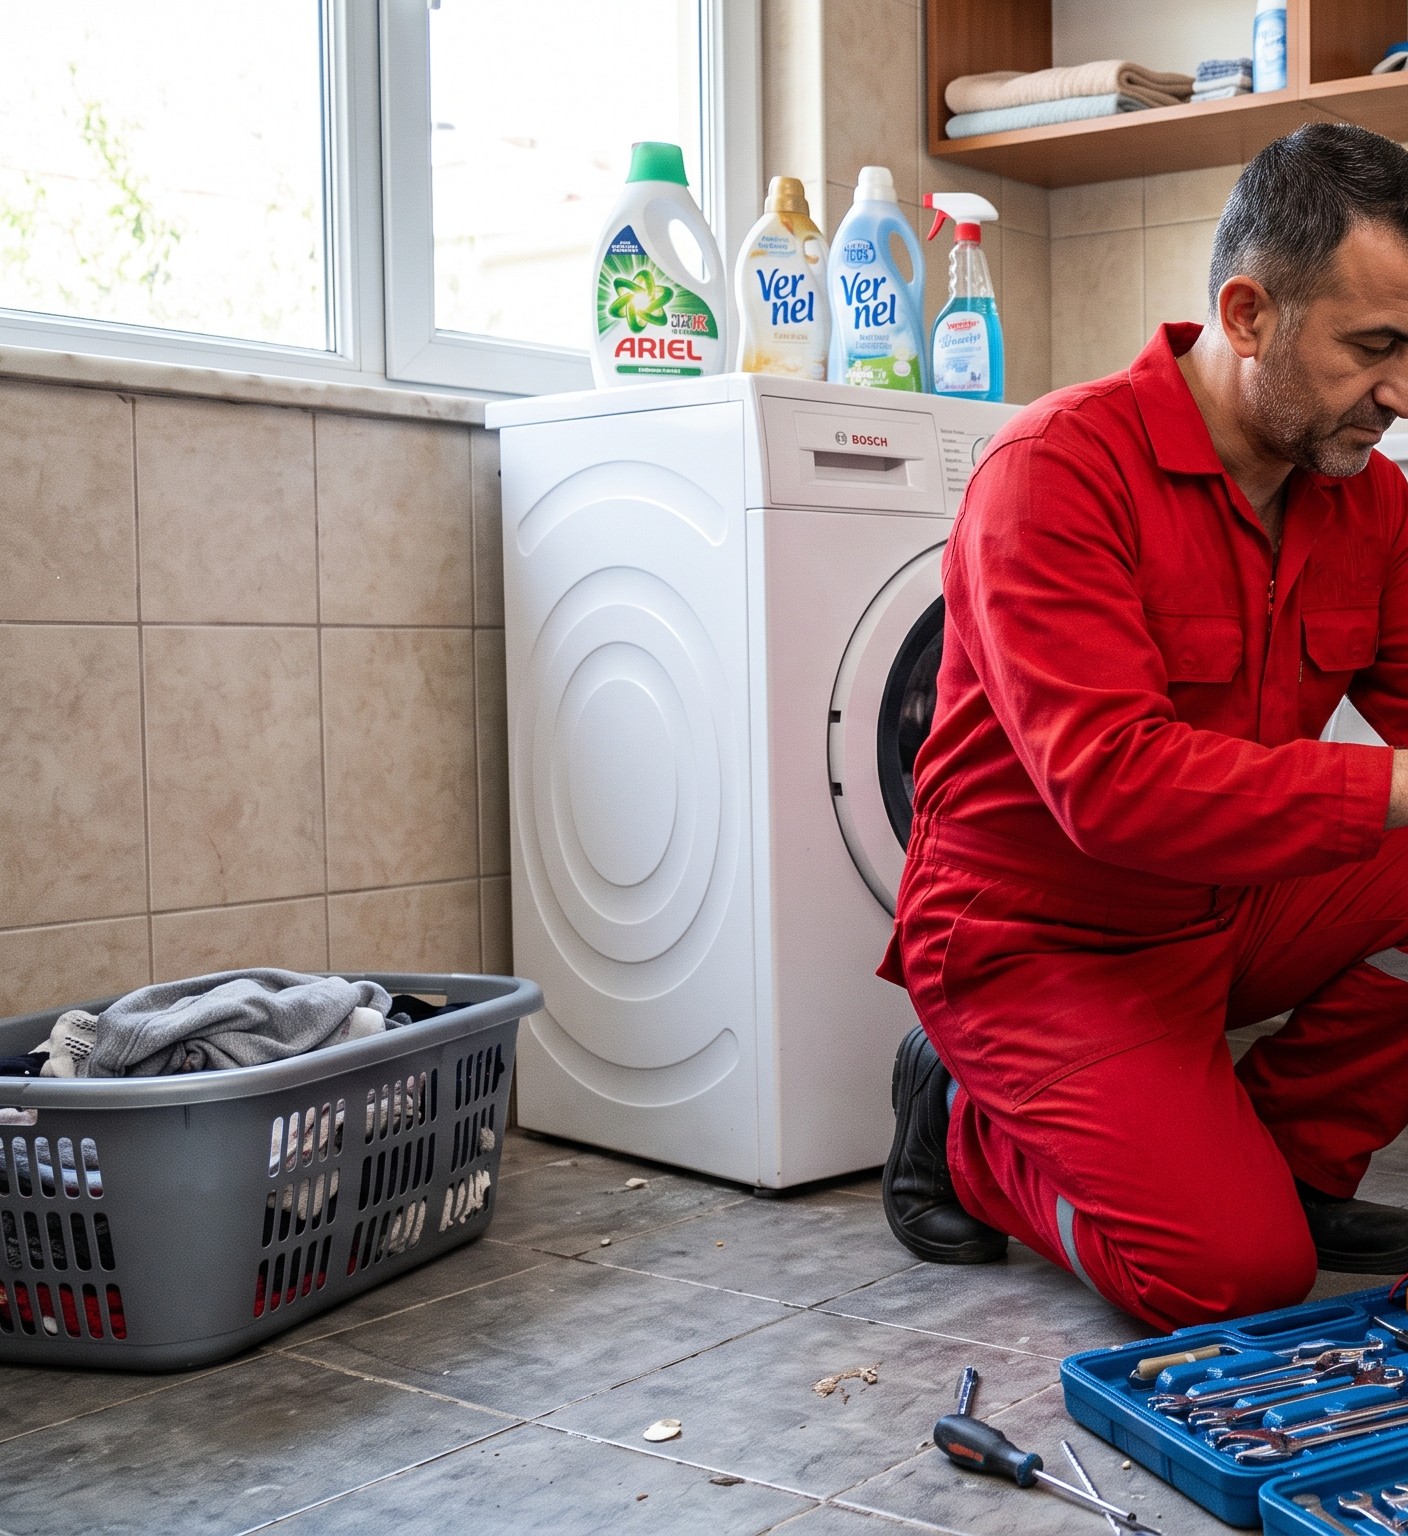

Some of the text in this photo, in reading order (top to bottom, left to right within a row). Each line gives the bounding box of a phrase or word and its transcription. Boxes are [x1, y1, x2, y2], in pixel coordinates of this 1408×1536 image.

[756, 268, 805, 302] Ver
[840, 272, 887, 306] Ver
[772, 291, 815, 326] nel
[854, 294, 896, 330] nel
[614, 337, 703, 361] ARIEL
[851, 434, 888, 447] BOSCH
